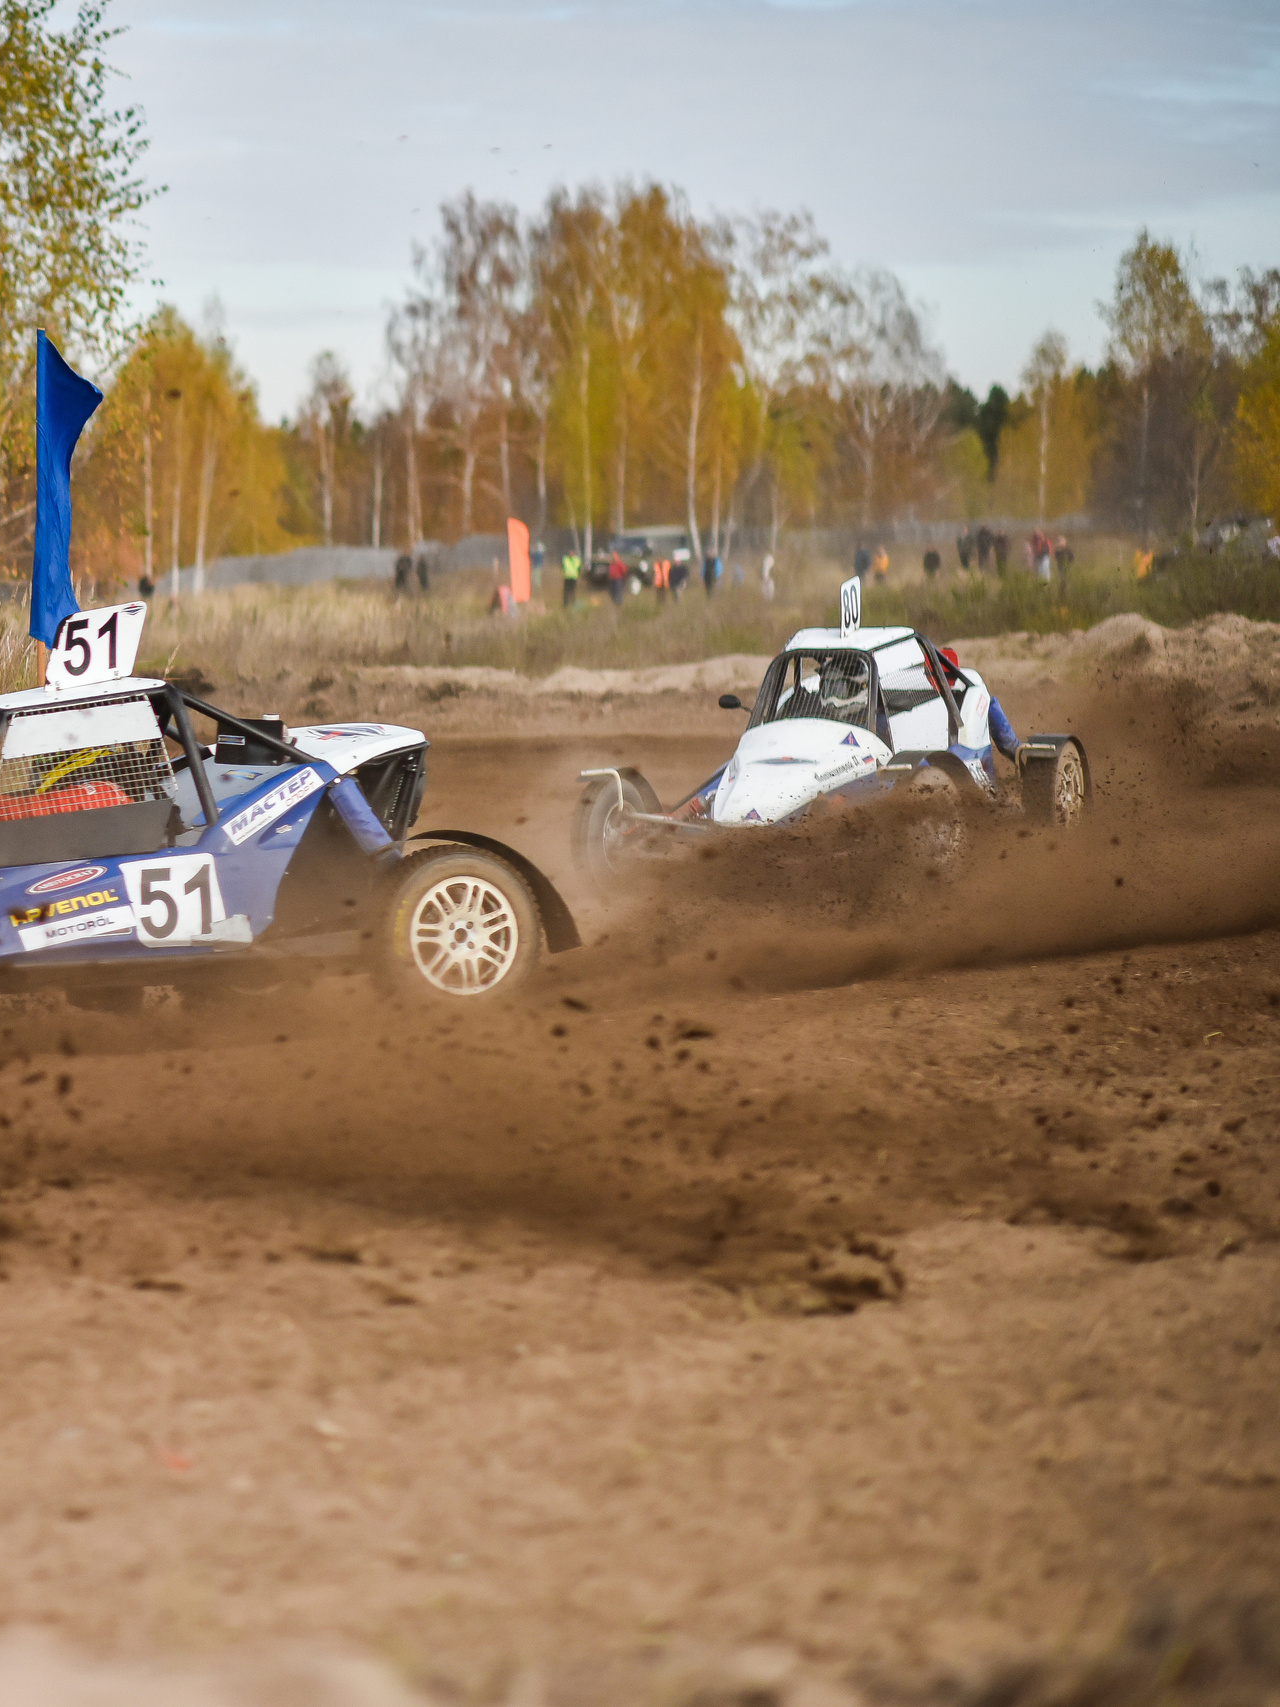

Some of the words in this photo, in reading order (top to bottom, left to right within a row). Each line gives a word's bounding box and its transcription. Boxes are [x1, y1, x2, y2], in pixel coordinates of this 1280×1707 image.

[843, 585, 858, 628] 80
[63, 612, 118, 676] 51
[231, 769, 311, 835] МАСТЕР
[46, 916, 115, 938] MOTORÖL
[140, 864, 212, 939] 51
